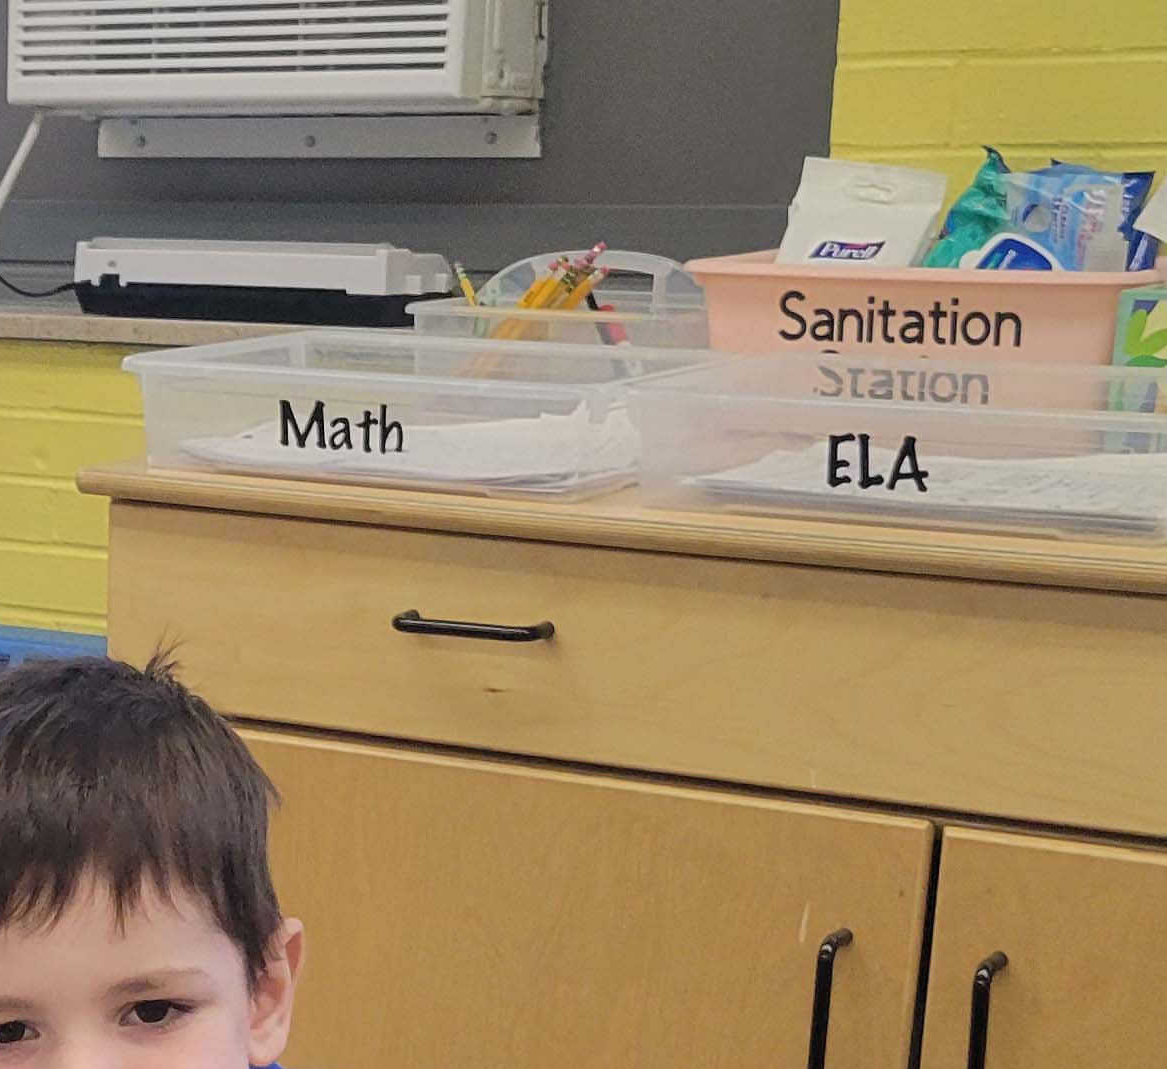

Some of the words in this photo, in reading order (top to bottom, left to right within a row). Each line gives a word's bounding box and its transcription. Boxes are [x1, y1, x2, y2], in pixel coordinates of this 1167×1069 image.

[778, 290, 1022, 347] Sanitation
[813, 349, 990, 405] Station
[279, 400, 404, 454] Math
[827, 433, 930, 492] ELA
